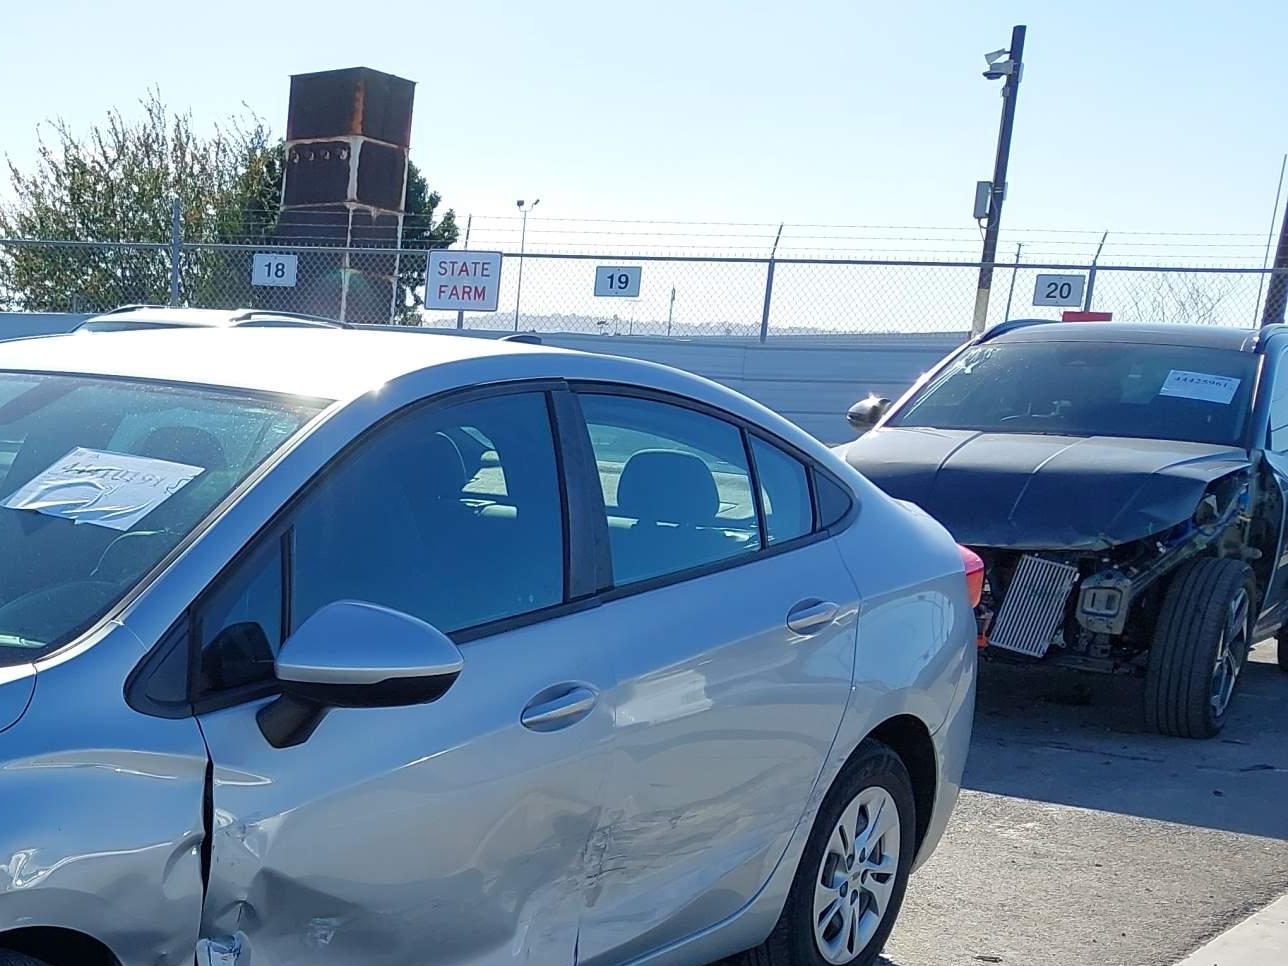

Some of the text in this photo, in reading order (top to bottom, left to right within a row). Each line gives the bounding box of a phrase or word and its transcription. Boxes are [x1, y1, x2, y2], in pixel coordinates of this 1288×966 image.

[263, 262, 285, 278] 18
[438, 260, 491, 278] STATE
[606, 273, 629, 290] 19
[437, 285, 487, 301] FARM
[1045, 282, 1072, 300] 20
